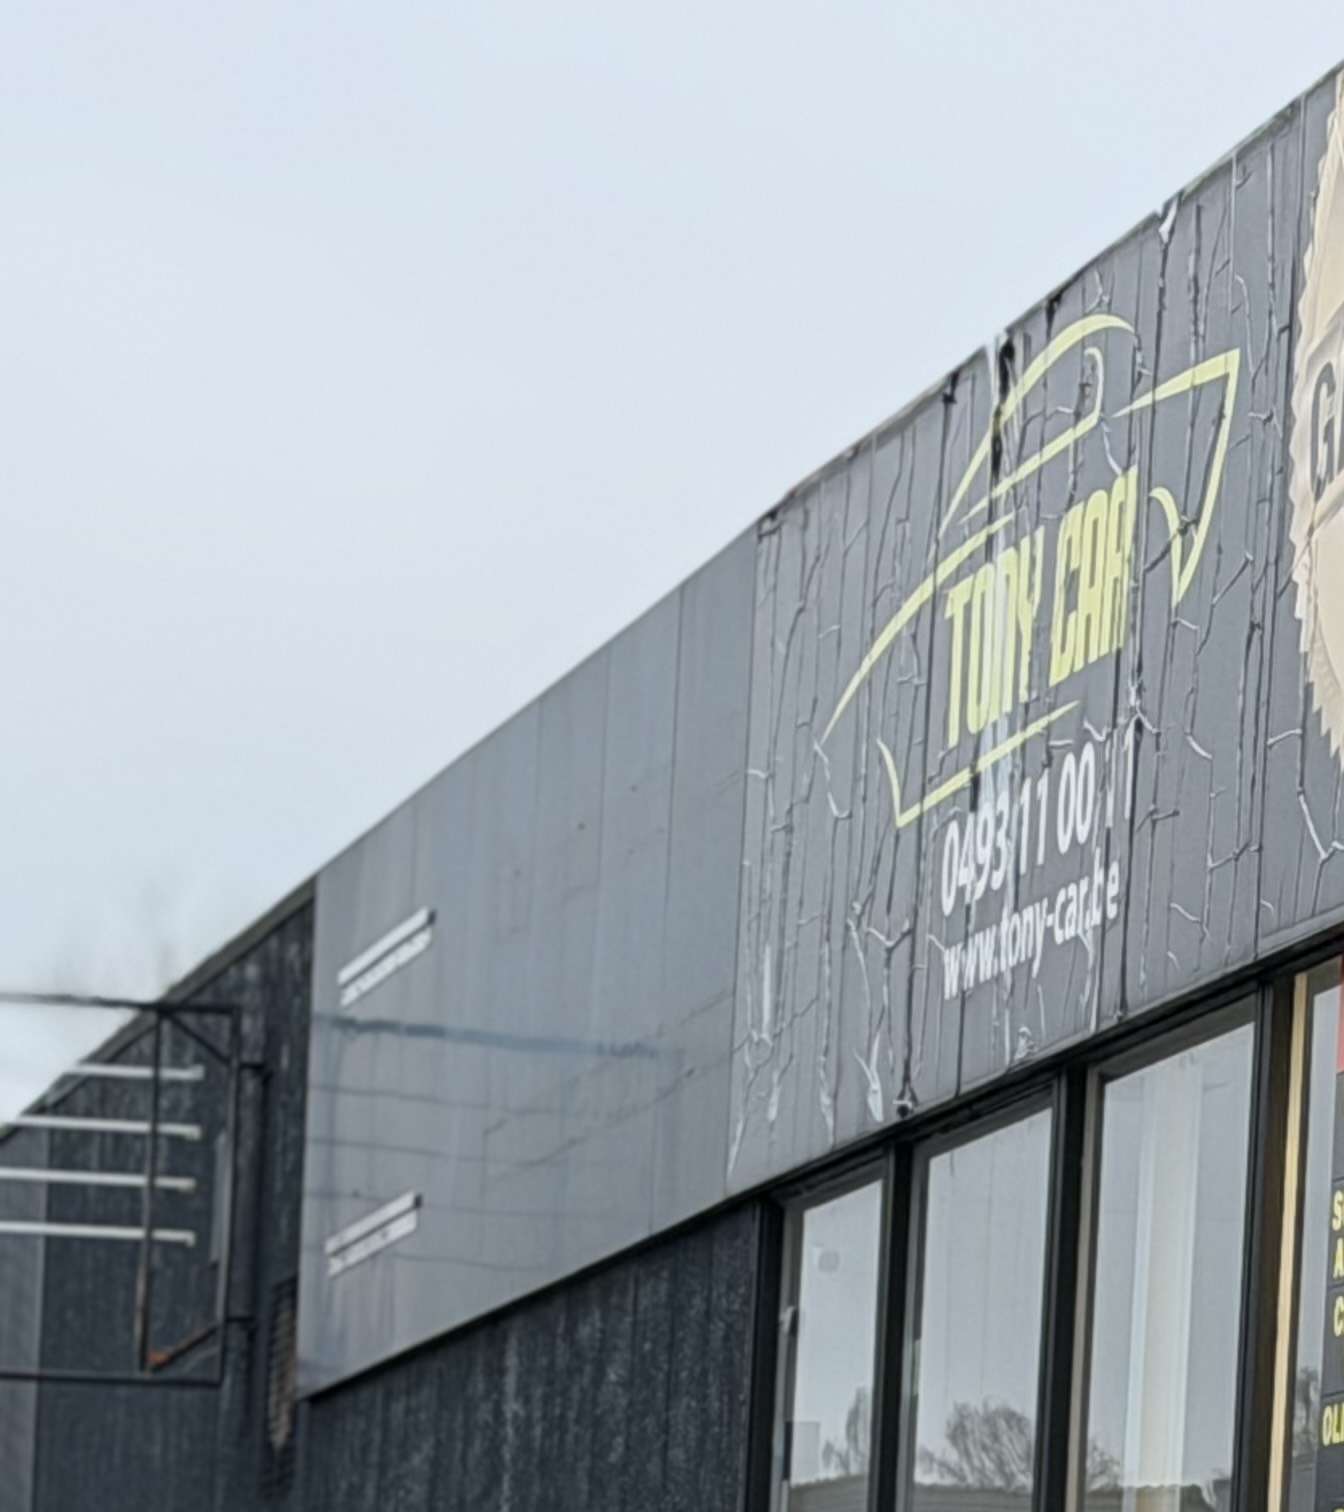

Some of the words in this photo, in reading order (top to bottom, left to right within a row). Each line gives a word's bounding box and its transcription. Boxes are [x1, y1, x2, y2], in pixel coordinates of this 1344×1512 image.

[944, 526, 1044, 748] TONY
[1050, 465, 1138, 688] CAR
[942, 797, 1011, 917] 0493
[1057, 742, 1095, 854] 00
[943, 847, 1120, 999] www.tony-car.be
